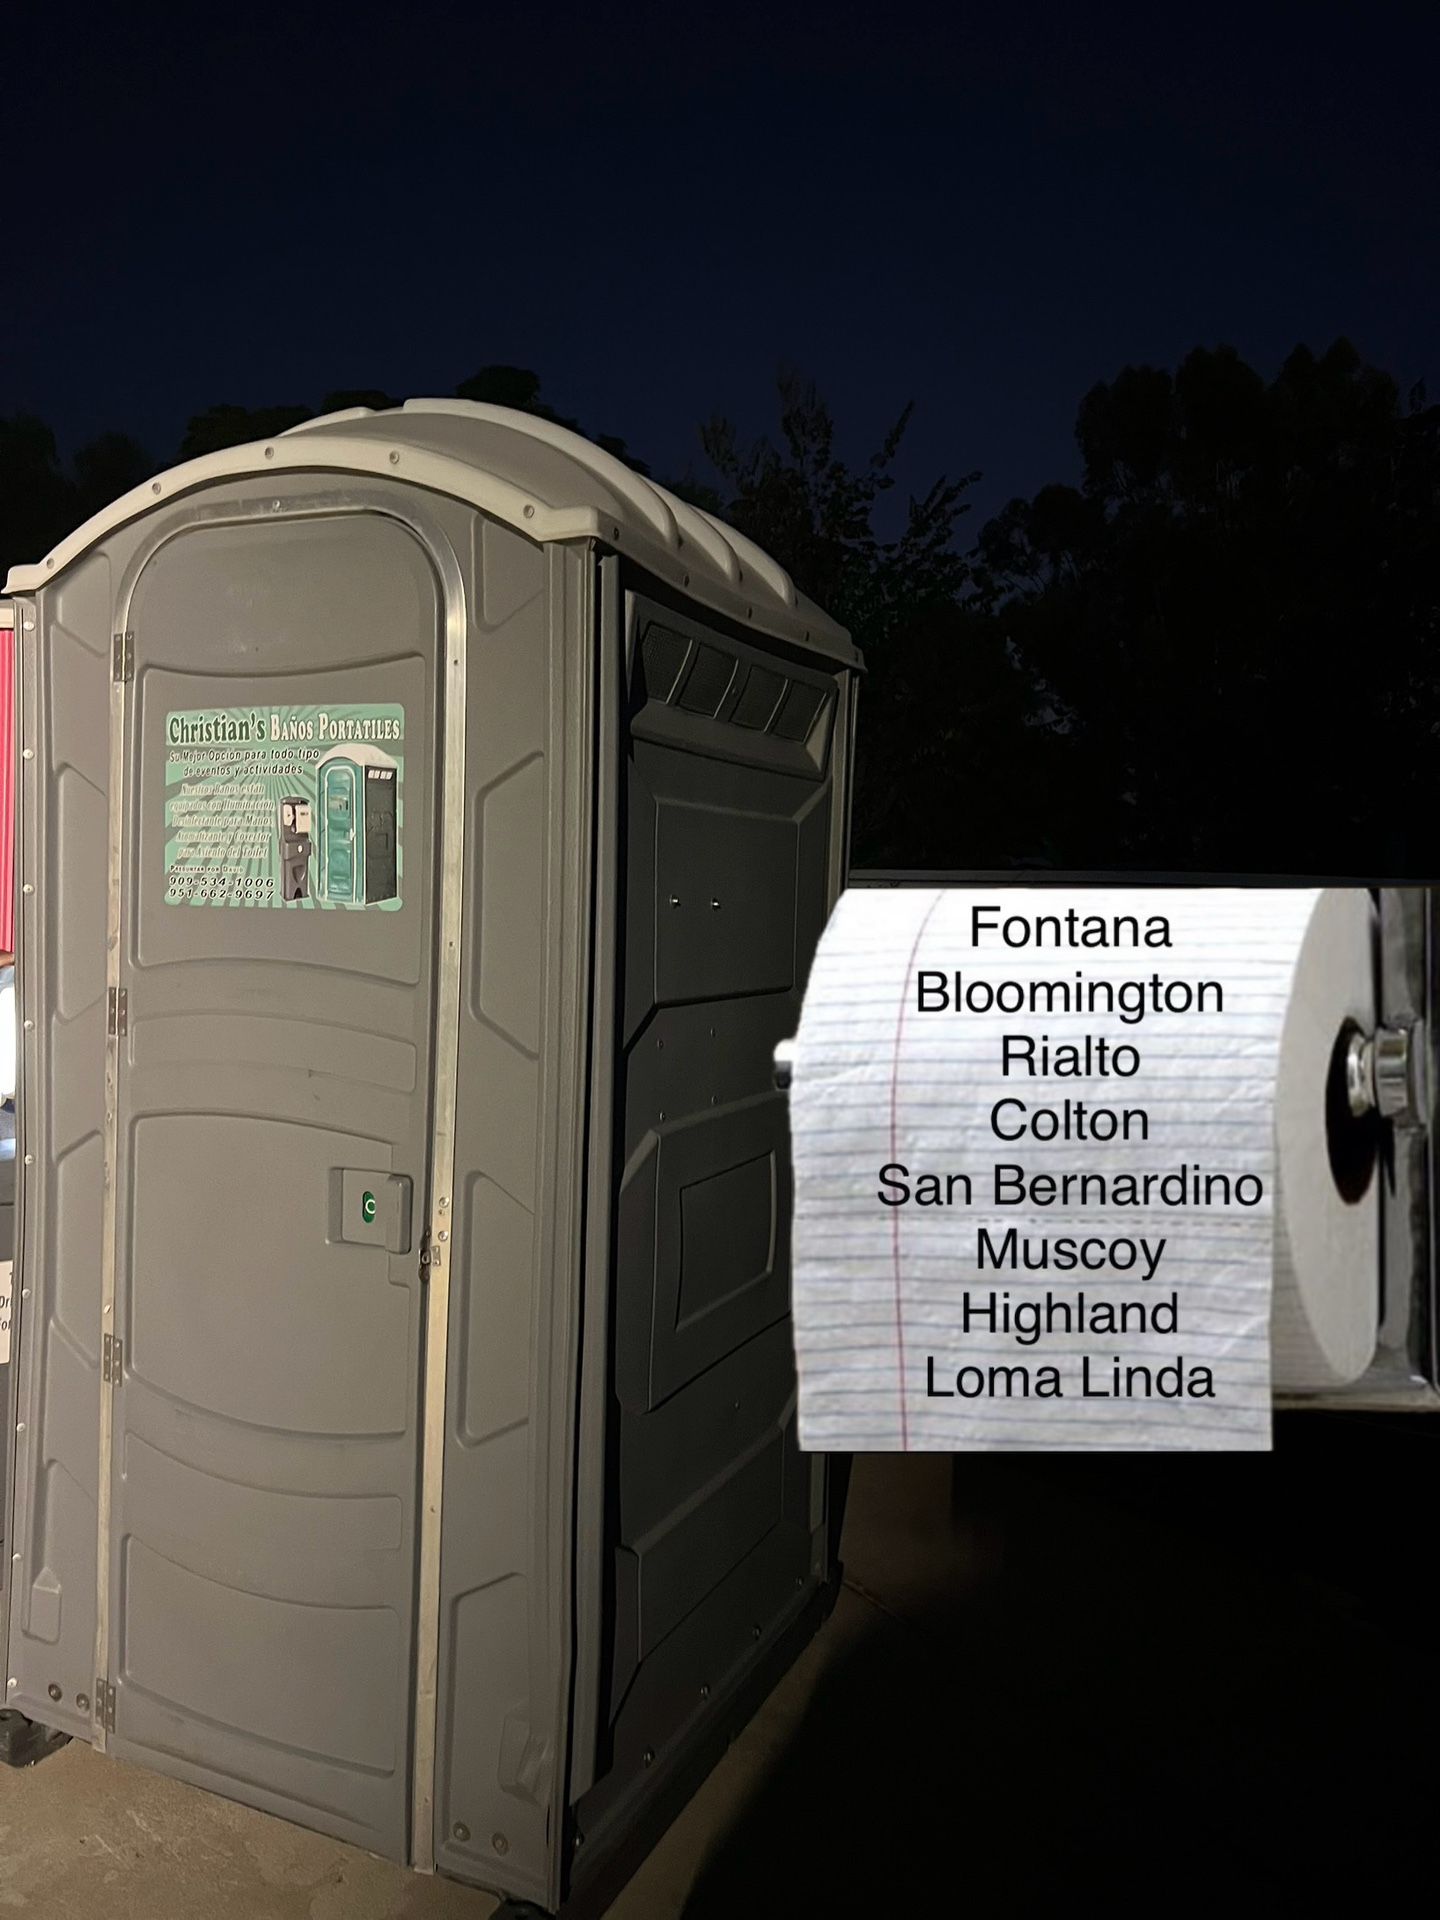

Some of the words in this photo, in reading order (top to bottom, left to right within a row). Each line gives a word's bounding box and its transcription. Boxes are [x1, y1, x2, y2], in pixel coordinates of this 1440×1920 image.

[169, 713, 266, 743] Christian's
[318, 713, 400, 740] PORTATILES
[170, 750, 180, 762] Su
[183, 750, 205, 764] Mejor
[245, 751, 267, 762] para
[271, 749, 294, 760] todo
[299, 748, 319, 762] tipo
[184, 766, 193, 776] de
[196, 766, 231, 776] eventos
[234, 767, 240, 778] y
[243, 763, 303, 775] actividades
[246, 814, 273, 827] Manos
[169, 876, 274, 888] 909-534-1006
[169, 888, 274, 900] 951-662-9697
